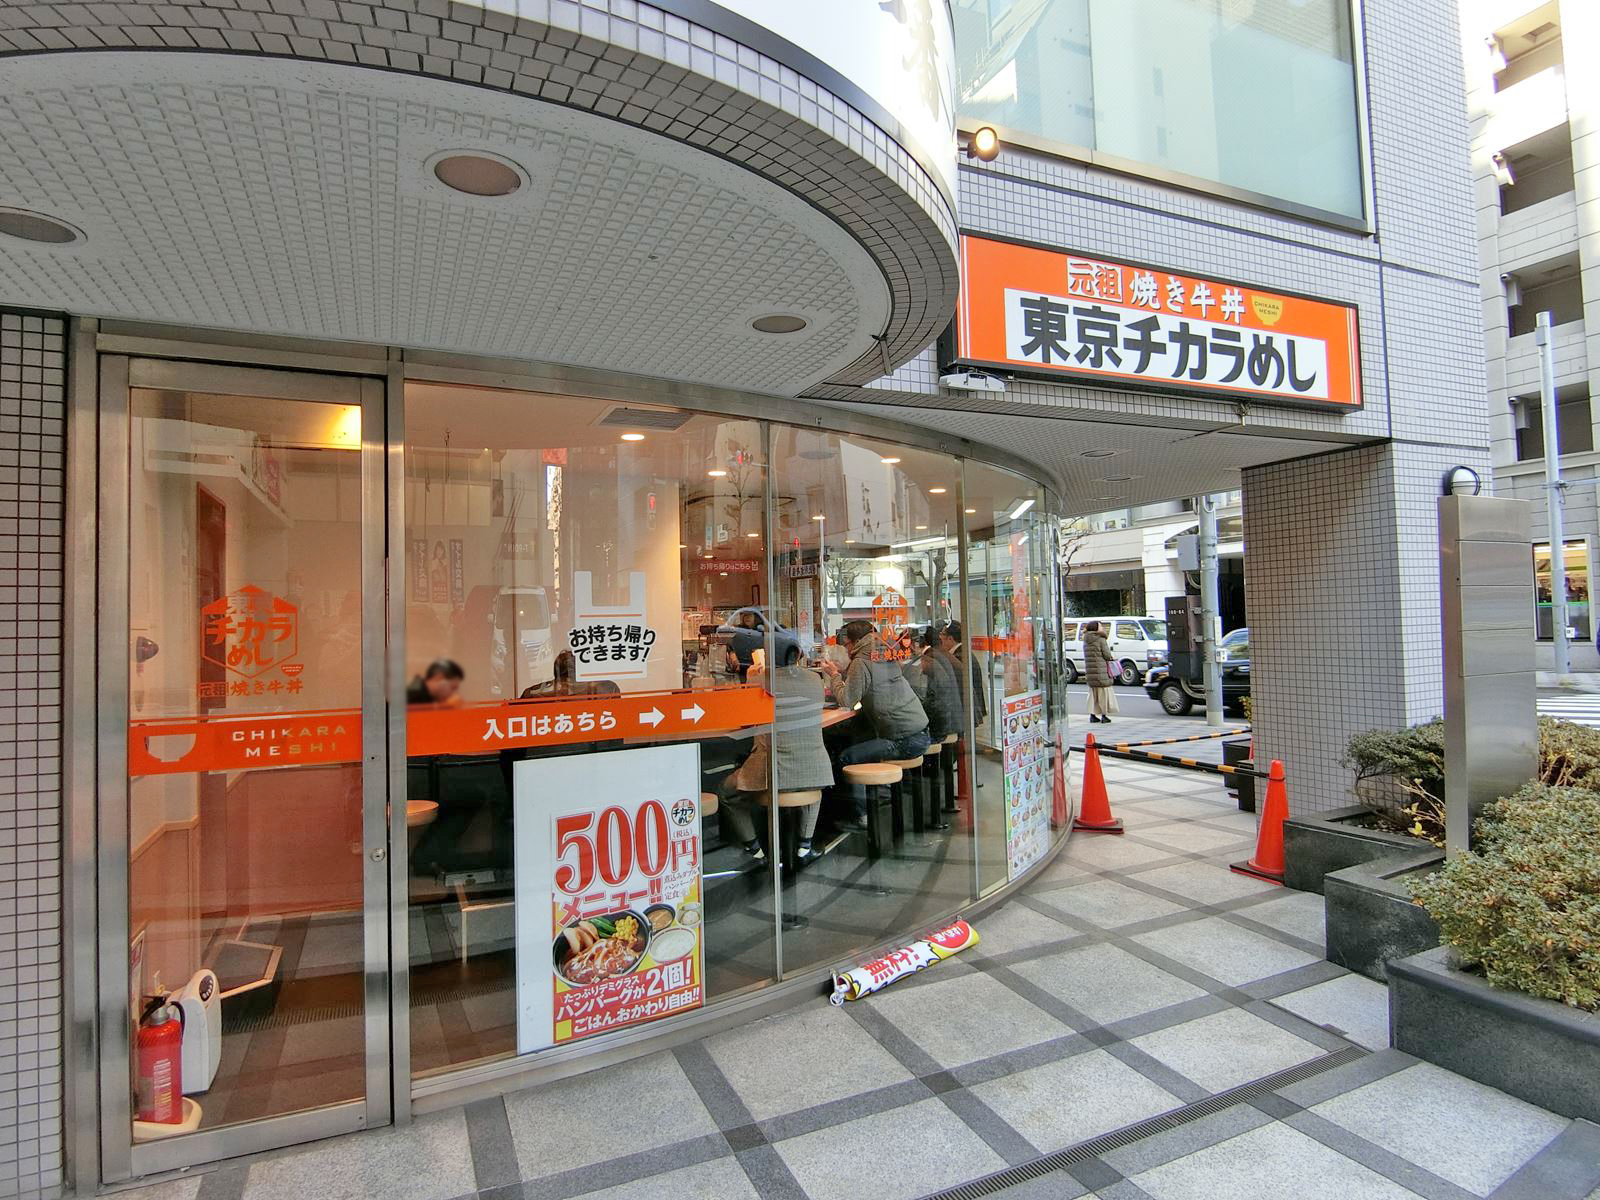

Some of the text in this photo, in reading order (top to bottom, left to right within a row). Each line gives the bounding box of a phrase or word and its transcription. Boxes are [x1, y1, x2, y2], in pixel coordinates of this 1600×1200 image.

[1069, 263, 1246, 324] 元祖 焼き牛丼
[1254, 301, 1280, 310] CHIKARA
[1020, 297, 1317, 392] 東京チカラめし
[207, 615, 292, 646] チカラ
[569, 625, 656, 647] お持ち帰り
[227, 638, 273, 667] めし
[574, 643, 650, 664] できます!
[230, 678, 304, 697] 焼き牛丼
[232, 725, 346, 742] CHIKARA
[482, 711, 617, 741] 入口はあちら
[245, 742, 336, 758] MESHI
[672, 806, 694, 818] チカラ
[564, 975, 640, 1004] たっぷりデミグラス
